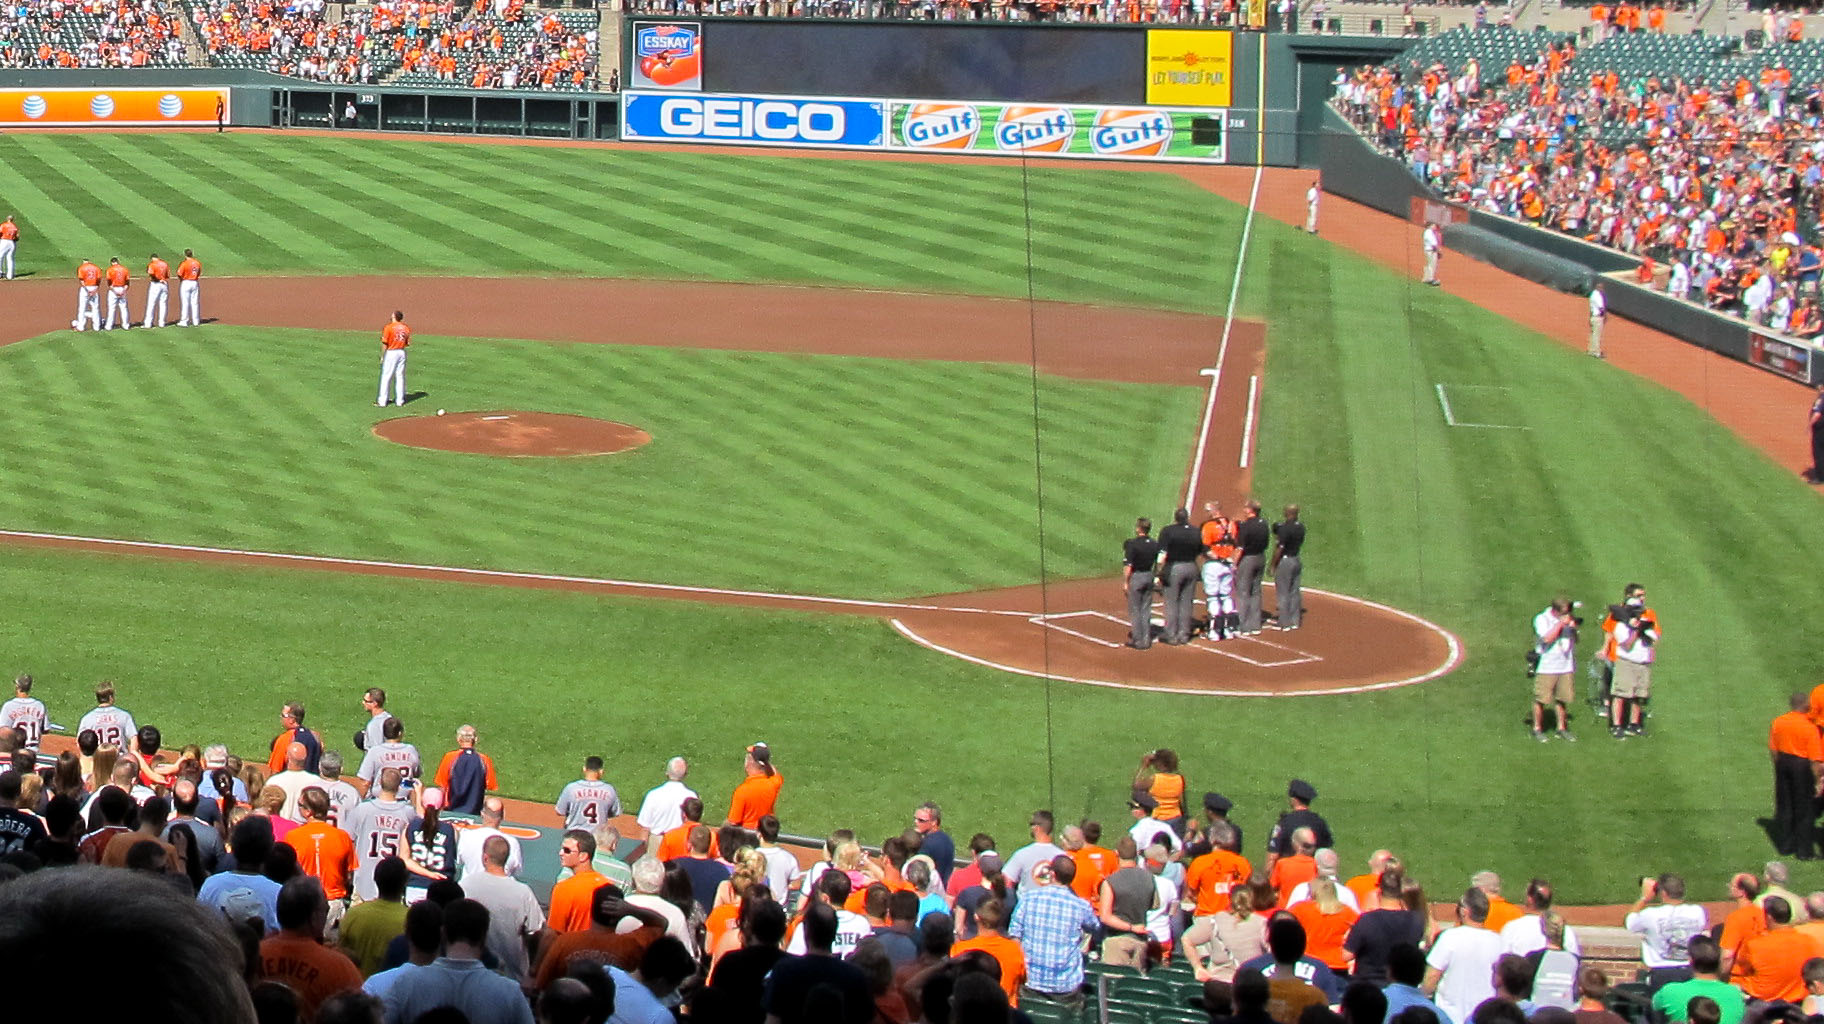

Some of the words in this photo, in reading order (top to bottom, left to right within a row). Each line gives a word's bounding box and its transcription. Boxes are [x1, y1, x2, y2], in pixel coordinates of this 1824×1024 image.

[644, 35, 690, 49] ESSKAY
[660, 98, 847, 141] GEICO
[908, 112, 973, 142] Gulf
[1000, 114, 1066, 147] Gulf
[1095, 116, 1164, 149] Gulf
[96, 727, 121, 747] 12
[375, 815, 401, 829] INGE
[583, 803, 597, 823] 4
[368, 831, 400, 858] 15
[262, 957, 320, 985] EAVER
